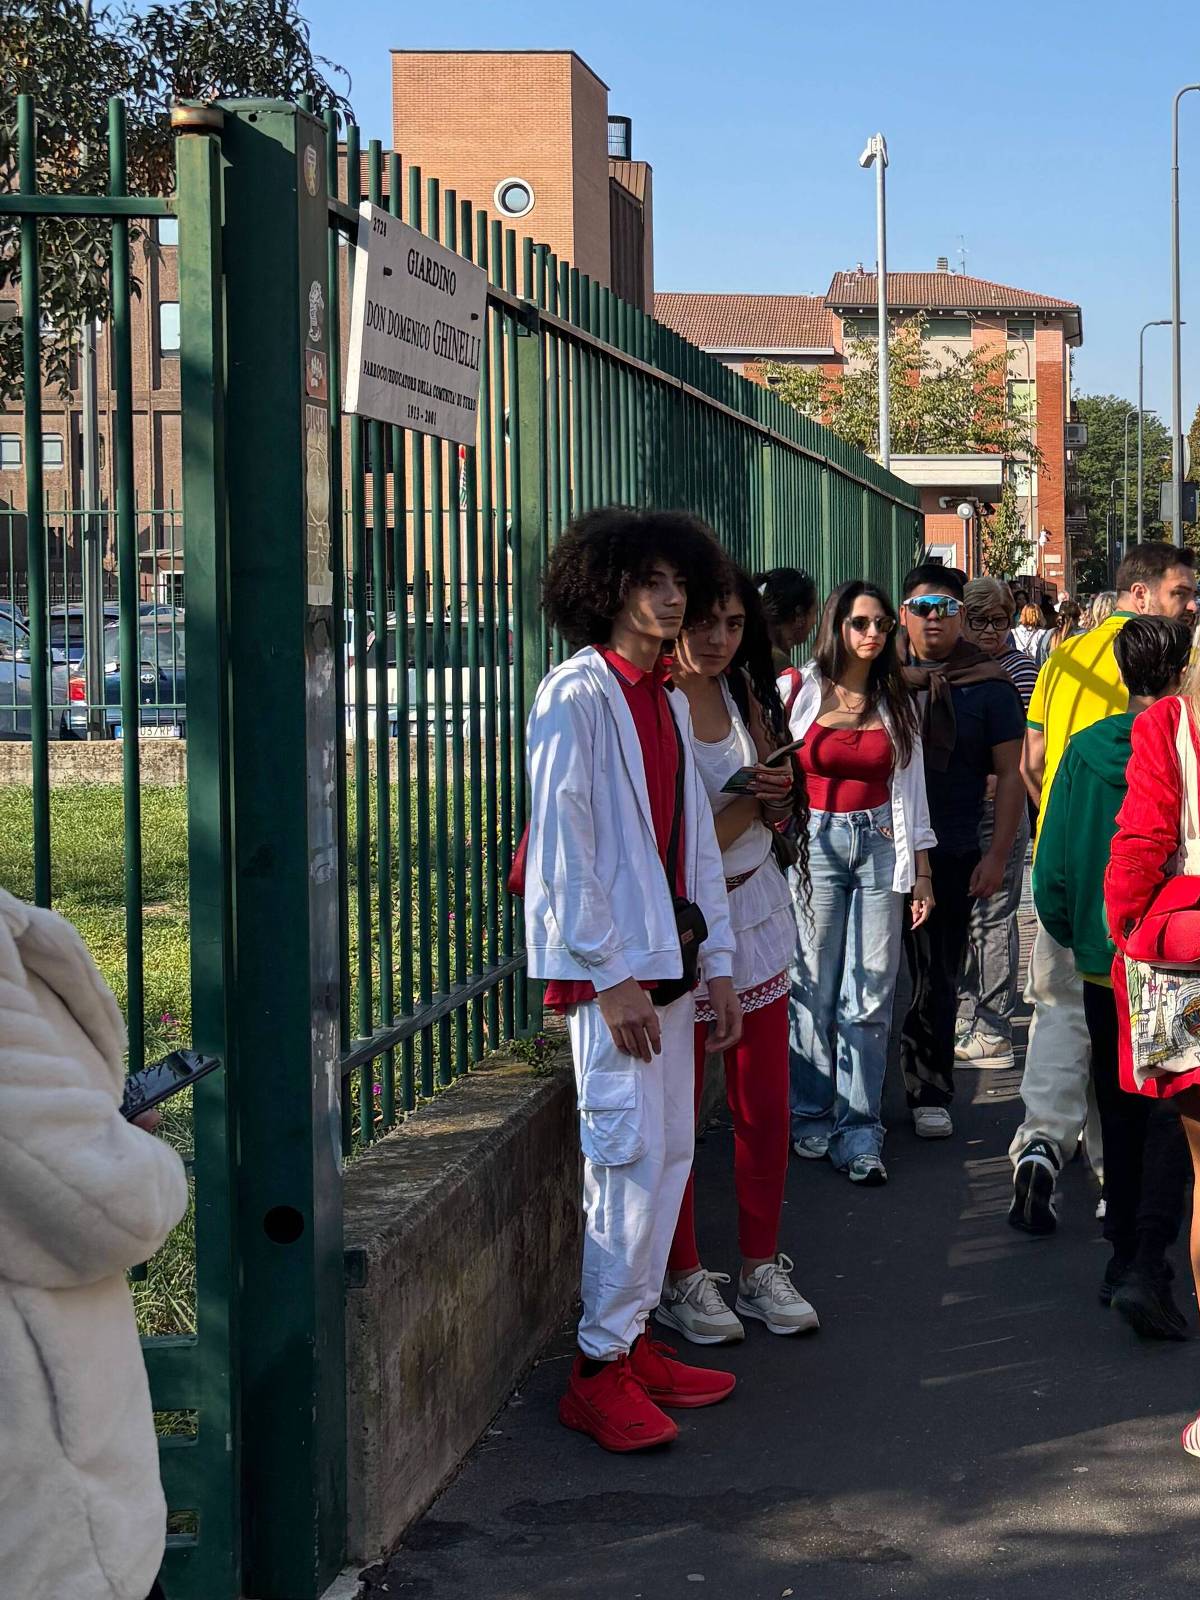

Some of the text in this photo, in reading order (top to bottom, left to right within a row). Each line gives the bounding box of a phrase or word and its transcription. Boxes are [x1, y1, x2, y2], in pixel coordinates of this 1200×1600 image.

[407, 248, 457, 296] GIARDINO
[366, 300, 481, 371] DON DOMENICO GHINELLI
